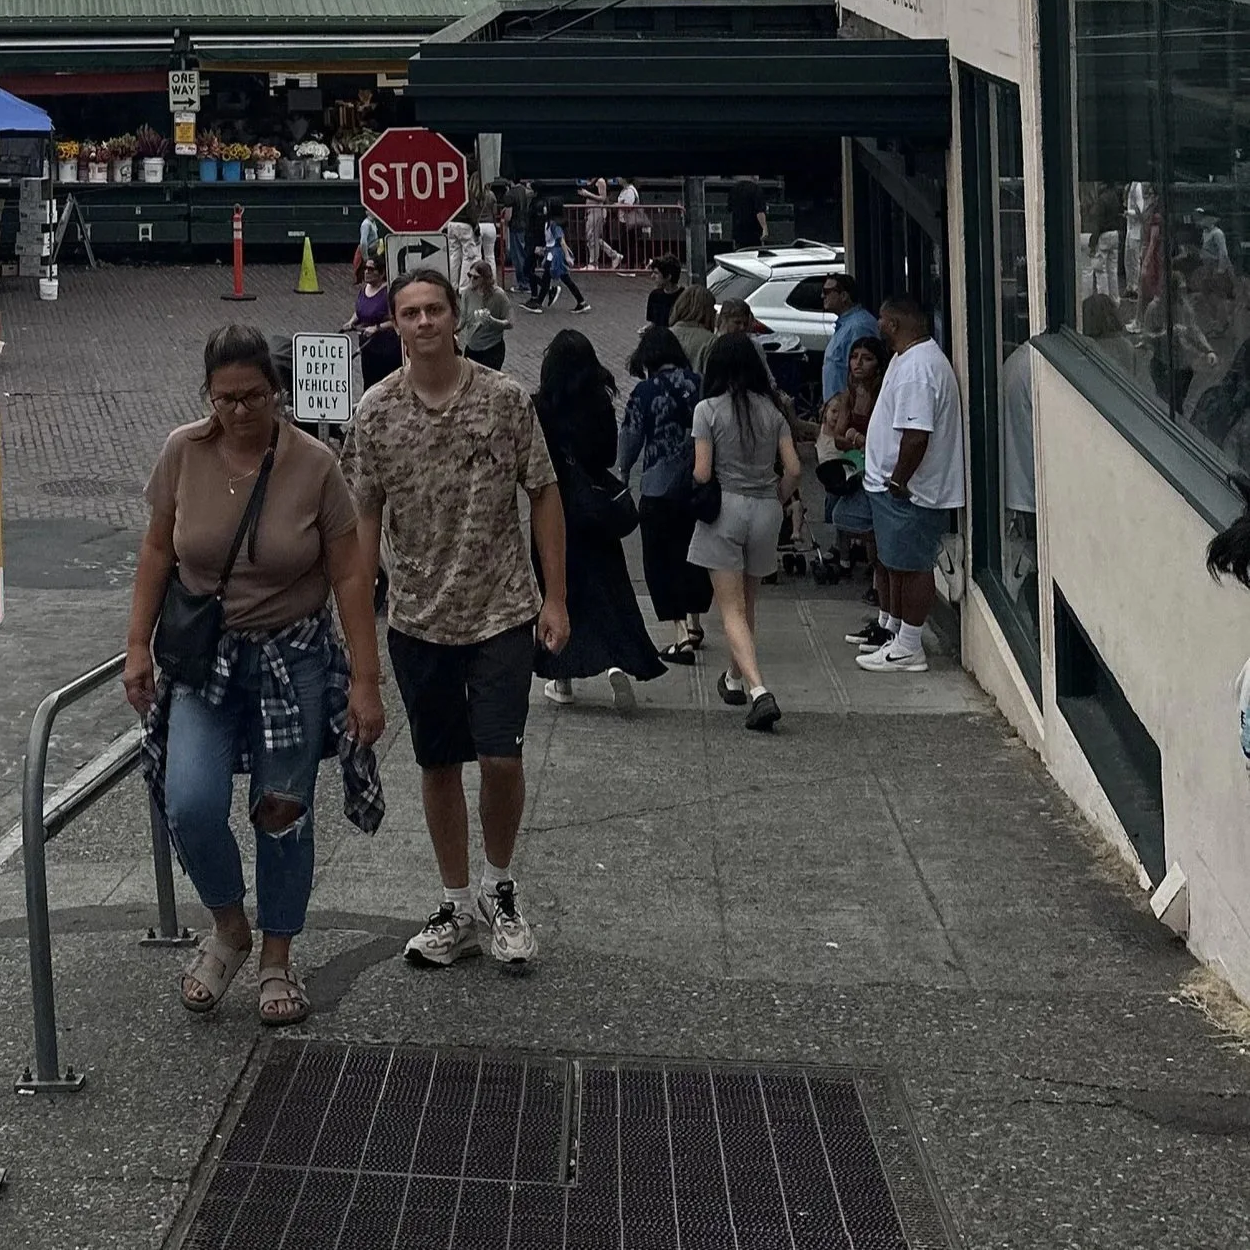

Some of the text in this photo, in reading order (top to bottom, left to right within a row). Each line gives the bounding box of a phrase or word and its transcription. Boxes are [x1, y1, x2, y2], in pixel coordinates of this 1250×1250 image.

[172, 73, 195, 84] ONE
[171, 85, 196, 95] WAY
[368, 161, 458, 200] STOP
[302, 345, 344, 358] POLICE
[307, 362, 335, 375] DEPT
[298, 379, 347, 393] VEHICLES
[308, 396, 338, 409] ONLY
